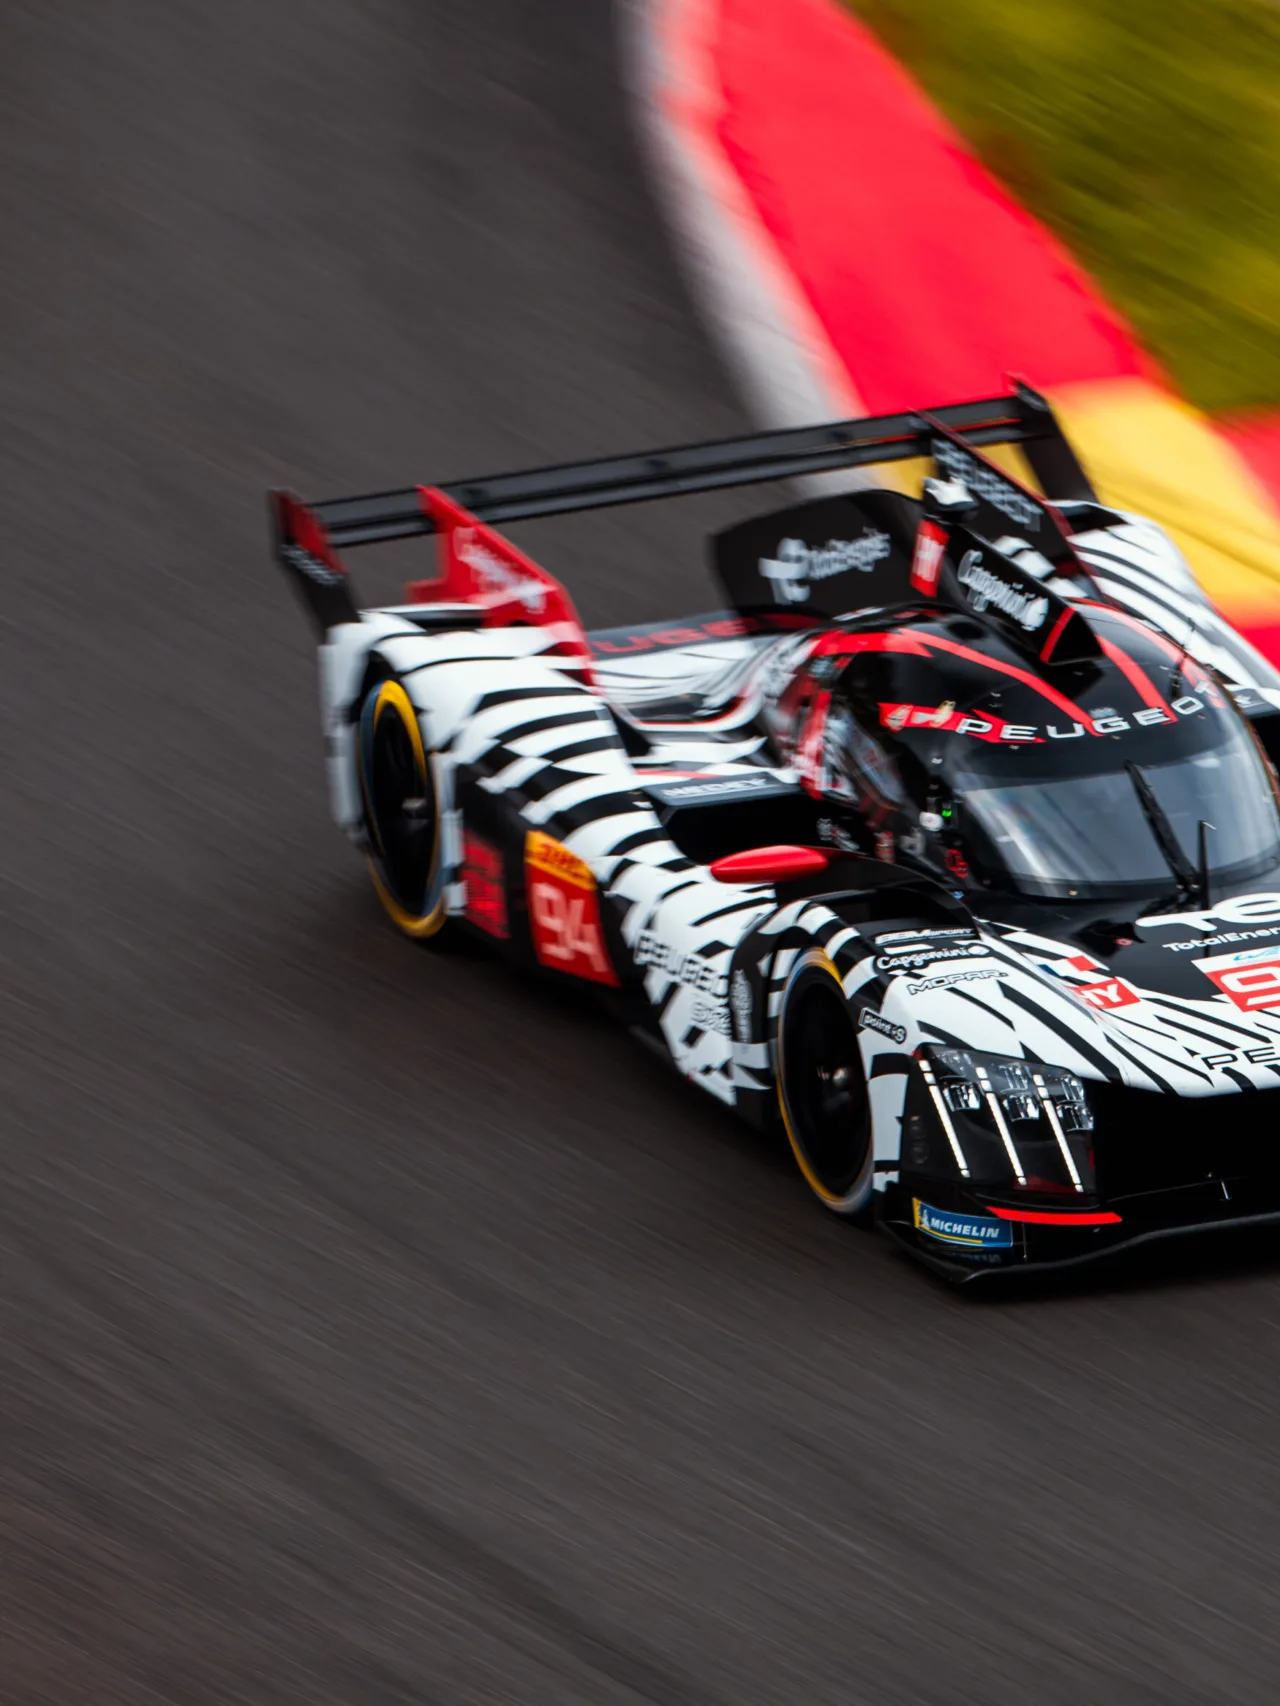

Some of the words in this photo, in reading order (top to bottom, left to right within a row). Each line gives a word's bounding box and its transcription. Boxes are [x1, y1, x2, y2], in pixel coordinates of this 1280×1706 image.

[531, 882, 609, 973] 94
[876, 948, 967, 970] Capgemini
[930, 1217, 1000, 1238] MICHELIN
